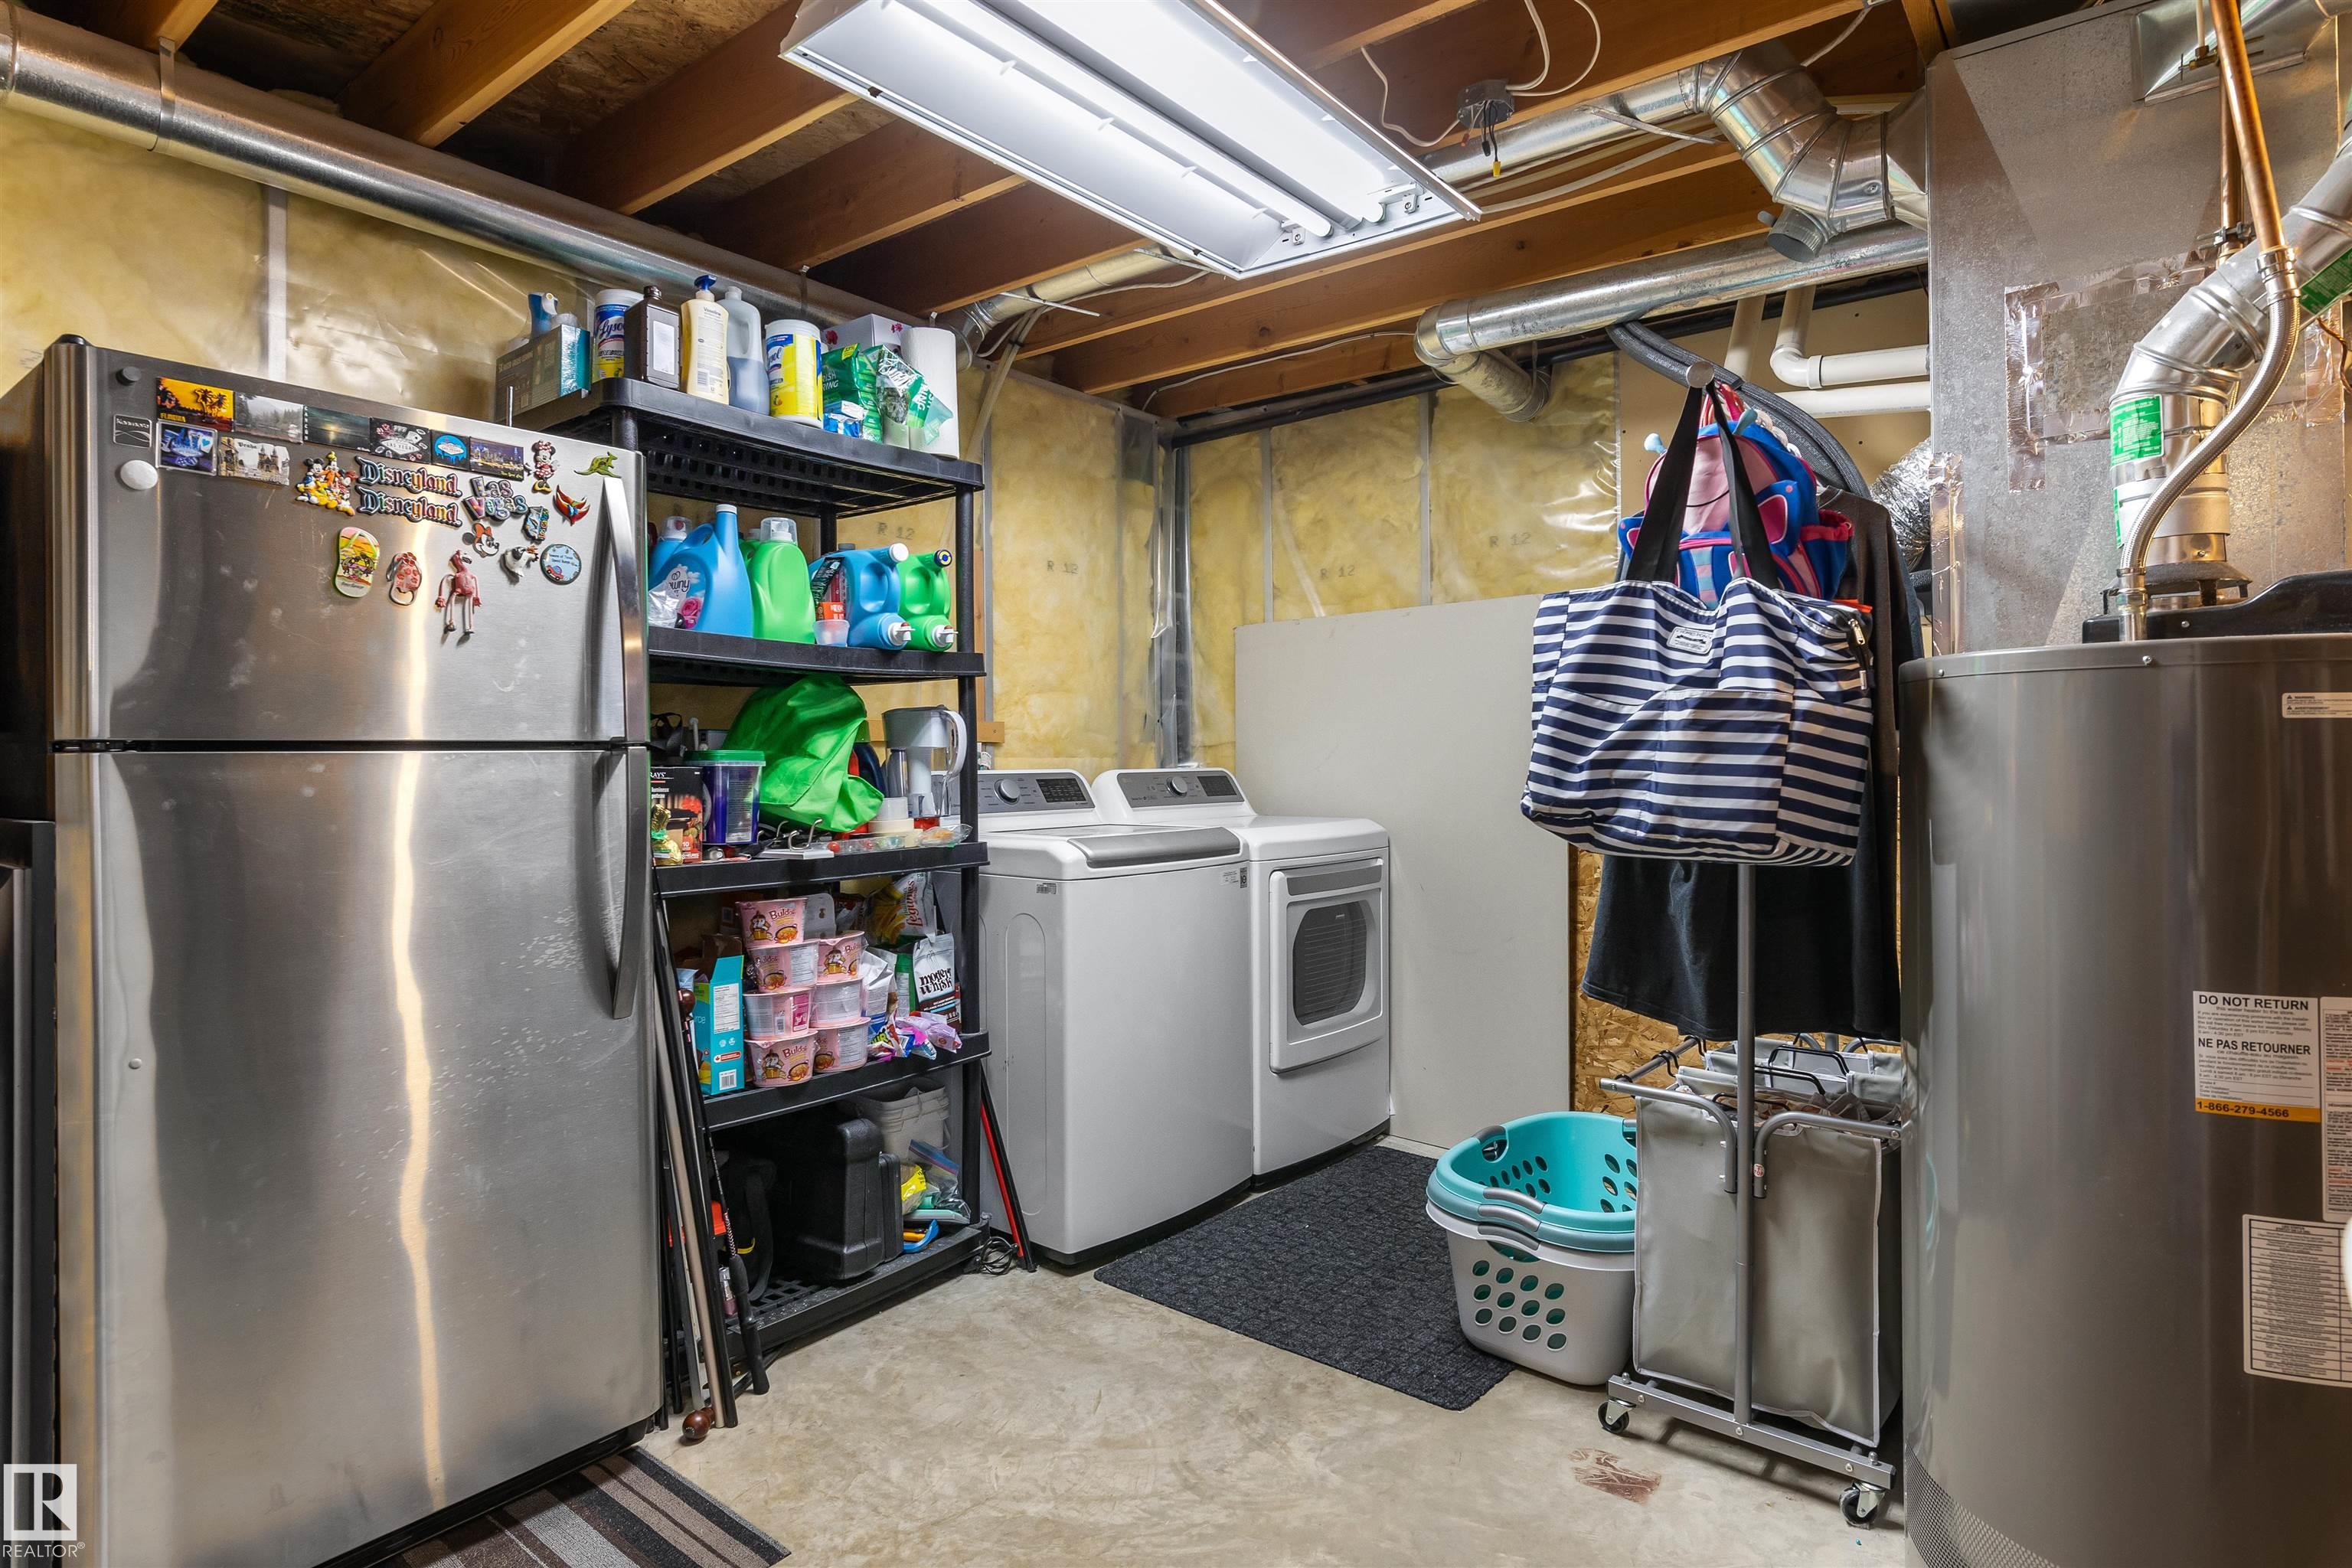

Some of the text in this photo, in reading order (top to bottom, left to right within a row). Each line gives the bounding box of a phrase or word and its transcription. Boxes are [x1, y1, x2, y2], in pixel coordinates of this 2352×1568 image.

[599, 316, 625, 340] Lyso
[822, 371, 837, 383] RISH
[822, 380, 840, 392] RING
[355, 455, 463, 497] Disneyland
[470, 476, 514, 498] Las
[354, 485, 463, 528] Disneyland
[462, 495, 529, 521] Vegas
[877, 522, 916, 541] R 12
[1510, 532, 1531, 546] 12
[1047, 560, 1054, 572] R
[1320, 564, 1355, 580] R 12
[2199, 995, 2309, 1011] DO NOT RETURN
[2198, 1037, 2311, 1055] NE PAS RETOURNER
[2197, 1101, 2289, 1118] 1-866-279-4566
